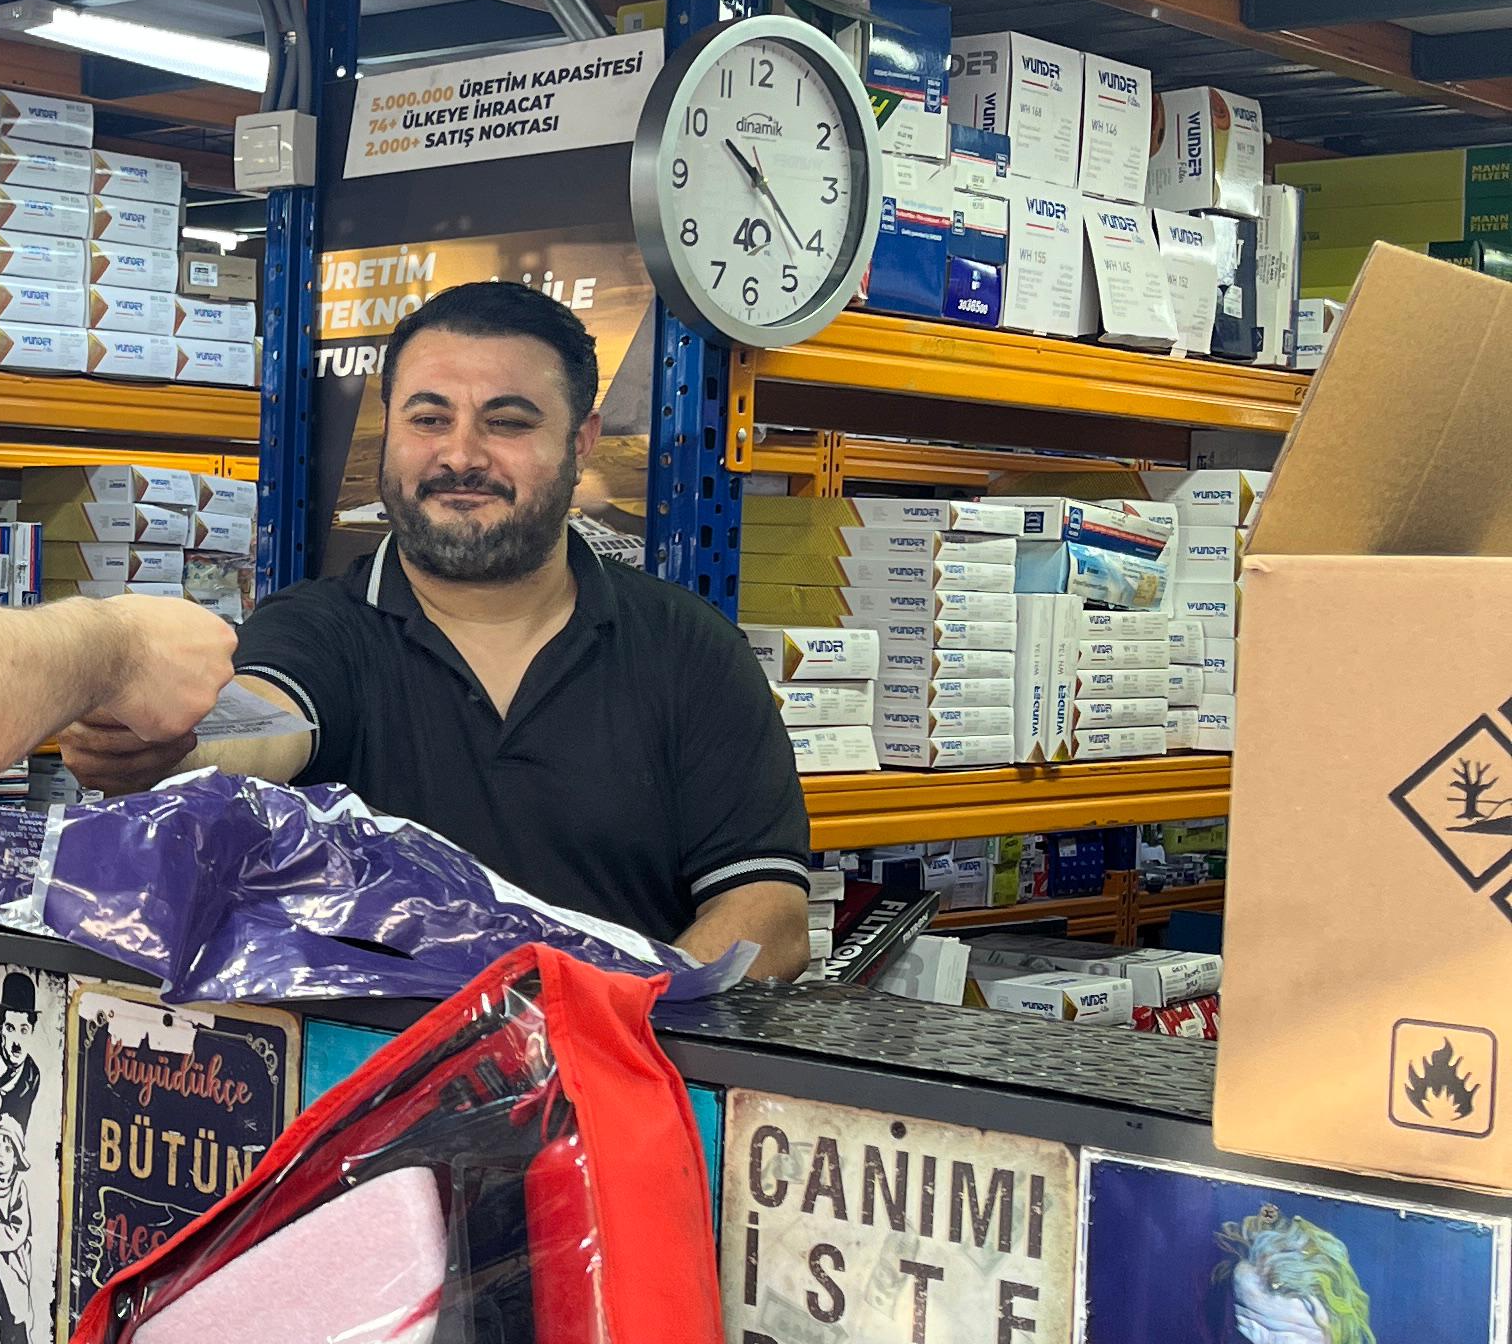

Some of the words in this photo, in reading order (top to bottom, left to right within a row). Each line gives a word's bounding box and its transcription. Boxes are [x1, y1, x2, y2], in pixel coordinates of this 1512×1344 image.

[750, 57, 774, 89] 12
[1022, 55, 1060, 80] WUNDER
[371, 86, 454, 112] 5.000.000
[459, 71, 527, 99] ÜRETİM
[531, 51, 644, 88] KAPASİTESİ
[721, 68, 733, 98] 11
[1098, 69, 1138, 95] WUNDER
[369, 118, 397, 135] 74+
[402, 105, 469, 130] ÜLKEYE
[473, 93, 555, 120] İHRACAT
[686, 106, 708, 137] 10
[736, 117, 783, 137] dinamik
[1233, 106, 1257, 121] WUNDER
[365, 136, 420, 157] 2.000+
[424, 127, 474, 149] SATIŞ
[479, 116, 559, 142] NOKTASI
[816, 122, 831, 151] 2
[1188, 110, 1203, 178] WUNDER
[672, 158, 688, 189] 9
[1471, 173, 1510, 182] FILTER
[1472, 163, 1510, 174] MANN
[820, 177, 839, 205] 3
[1026, 196, 1067, 220] WUNDER
[1470, 213, 1509, 224] MANN
[680, 218, 699, 247] 8
[1097, 212, 1139, 233] WUNDER
[1170, 226, 1204, 246] WUNDER
[1470, 223, 1509, 233] FILTER
[805, 229, 825, 257] 4
[317, 246, 436, 293] ÜRETİM
[711, 260, 727, 290] 7
[781, 264, 799, 293] 5
[742, 276, 759, 306] 6
[116, 300, 144, 312] WUNDER
[194, 308, 222, 319] WUNDER
[1192, 490, 1233, 501] WUNDER
[903, 507, 940, 518] WUNDER
[1187, 602, 1227, 613] WUNDER
[889, 625, 925, 636] WUNDER
[807, 640, 844, 654] WUNDER
[1056, 684, 1067, 736] WUNDER
[884, 742, 921, 754] WUNDER
[825, 899, 909, 981] FILTRON
[104, 1038, 252, 1112] Büyüdükçe
